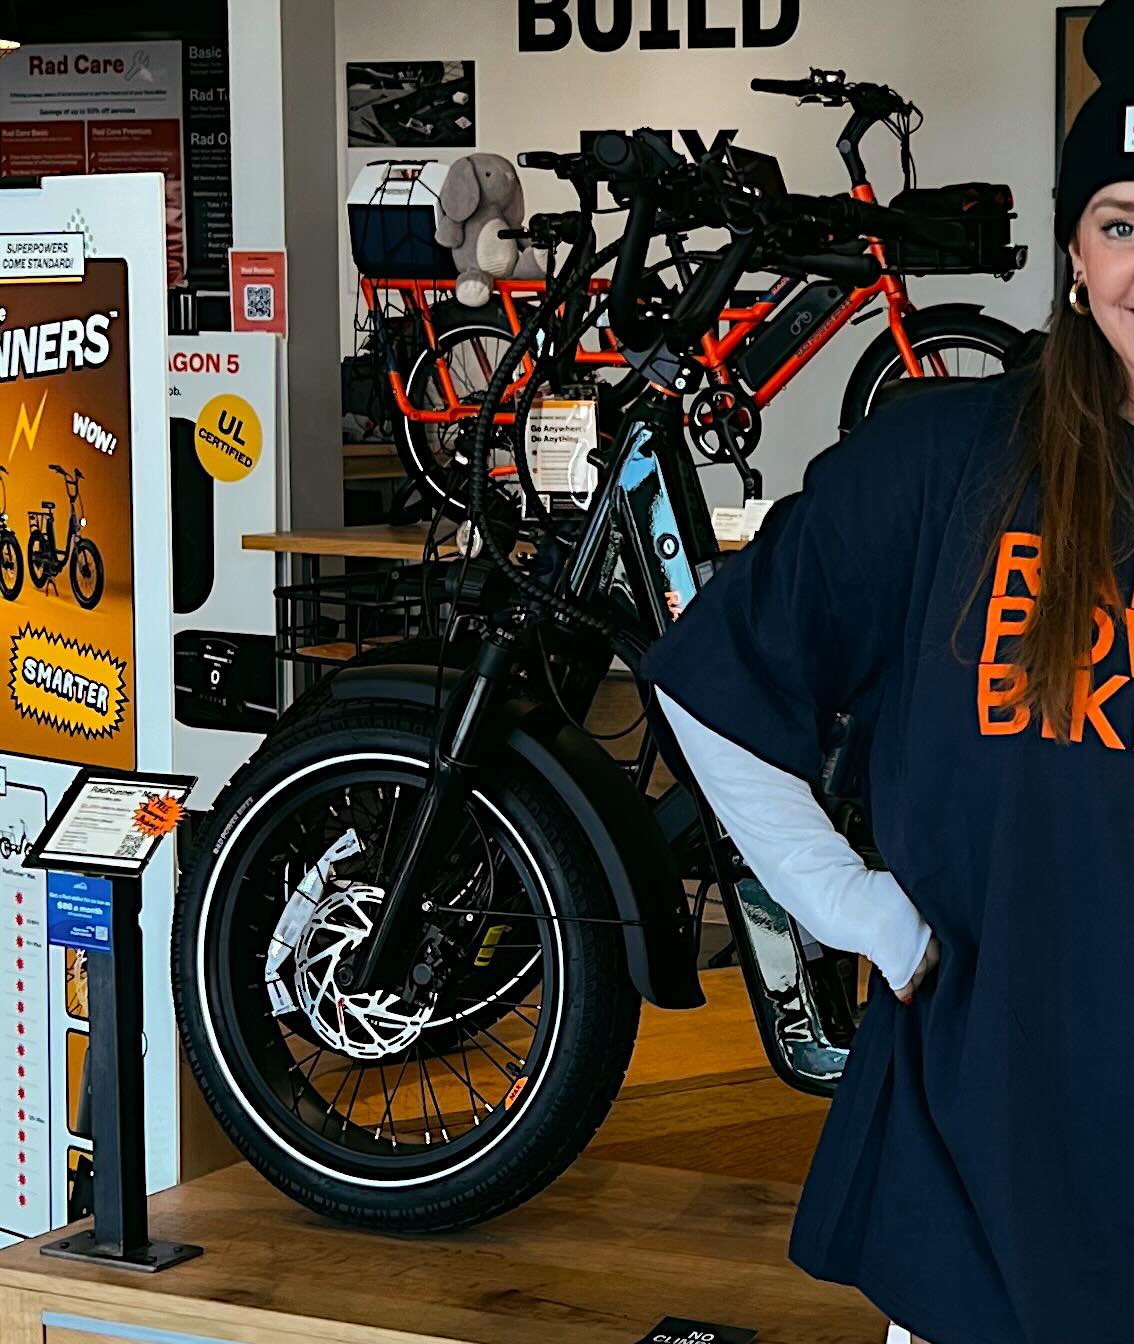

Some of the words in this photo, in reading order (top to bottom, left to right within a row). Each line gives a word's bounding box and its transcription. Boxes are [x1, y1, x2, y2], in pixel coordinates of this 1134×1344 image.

[189, 46, 222, 59] Basic
[29, 55, 68, 76] Rad
[74, 54, 125, 74] Care
[190, 88, 214, 102] Rad
[191, 132, 214, 146] Rad
[7, 242, 68, 254] SUPERPOWERS
[3, 258, 26, 269] COME
[28, 257, 73, 269] STANDARD!
[227, 354, 240, 374] 5
[73, 412, 117, 455] WOW!
[217, 409, 245, 446] UL
[198, 427, 253, 468] CERTIFIED
[23, 656, 109, 713] SMARTER
[210, 669, 220, 685] 0
[687, 1331, 715, 1342] NO
